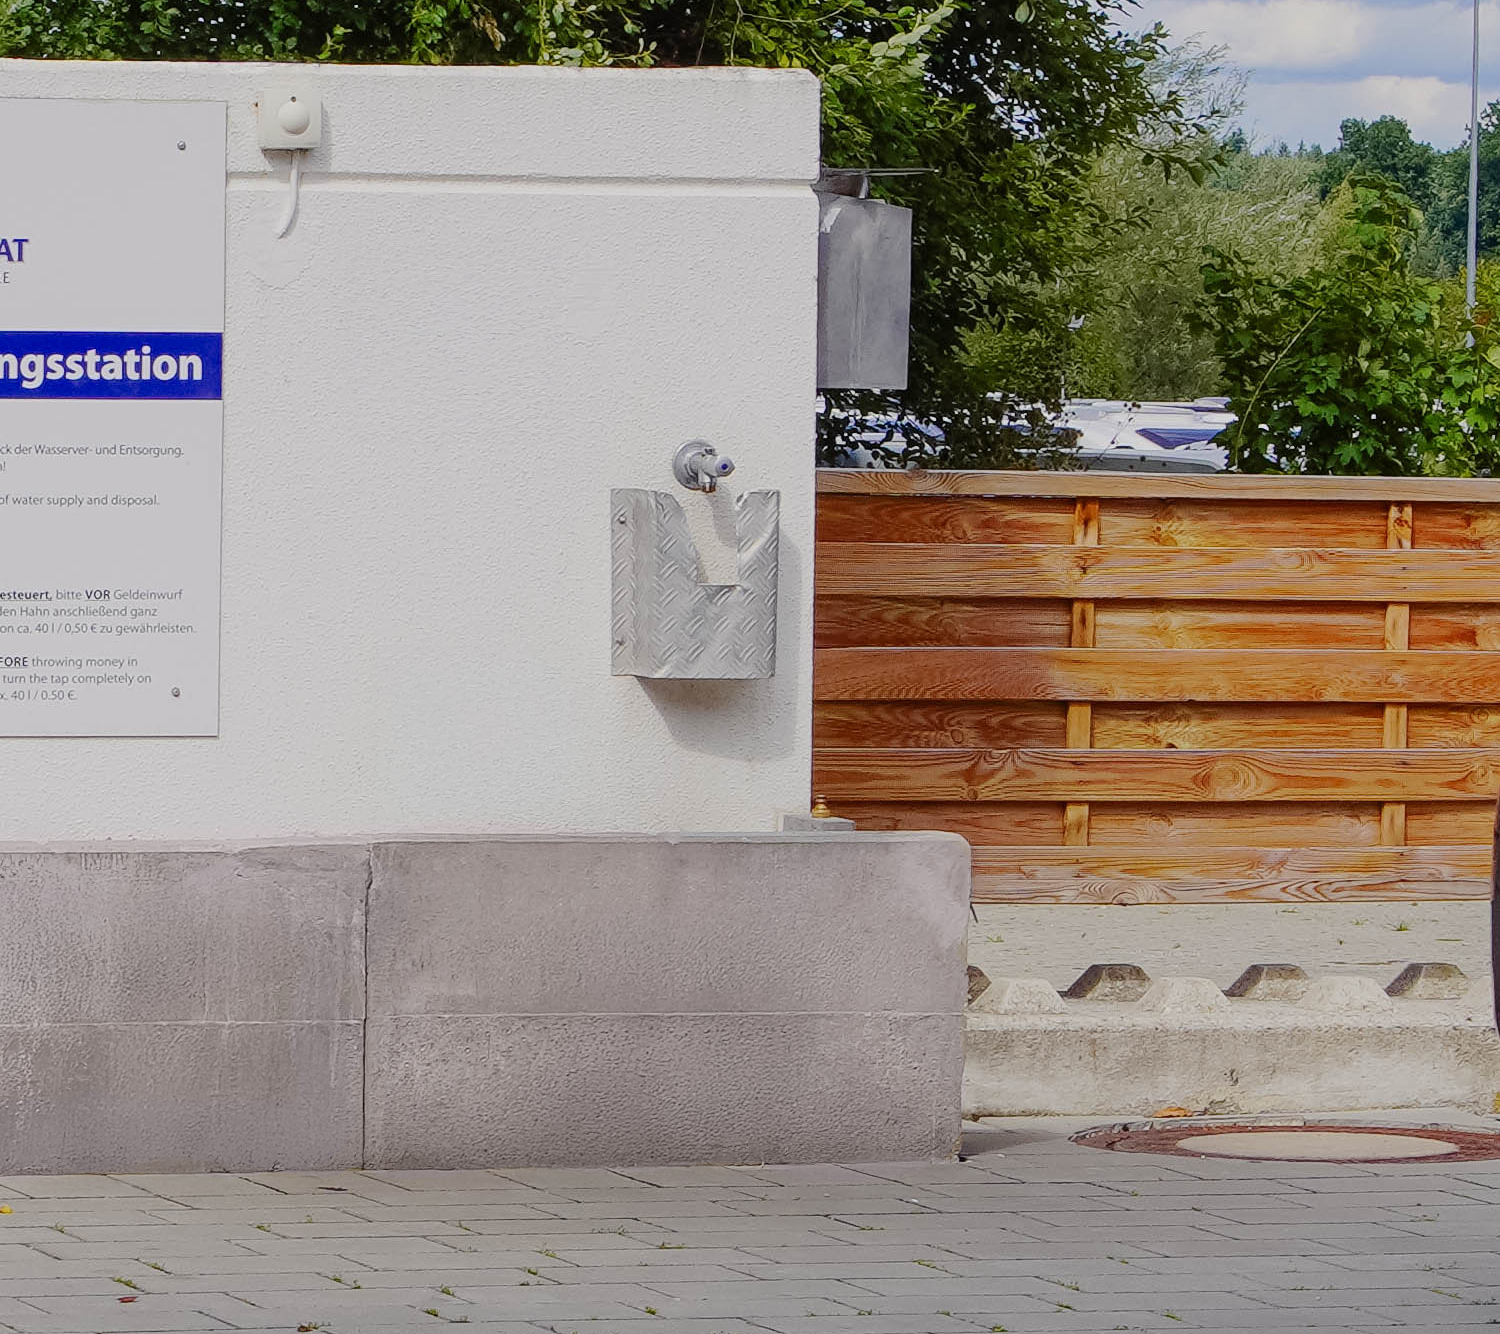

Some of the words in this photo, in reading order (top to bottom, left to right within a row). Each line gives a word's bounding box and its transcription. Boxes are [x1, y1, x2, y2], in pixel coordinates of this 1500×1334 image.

[14, 444, 32, 455] der
[35, 444, 93, 456] Wasserver-
[95, 444, 117, 456] und
[119, 444, 184, 458] Entsorgung.
[12, 495, 43, 506] water
[46, 494, 84, 508] supply
[86, 494, 108, 506] and
[111, 494, 160, 508] disposal.
[56, 588, 82, 600] bitte
[85, 588, 110, 600] VOR
[113, 588, 184, 600] Geldeinwurf
[20, 605, 50, 617] Hahn
[52, 605, 127, 617] anschließend
[130, 608, 158, 620] ganz
[35, 622, 48, 634] 40
[100, 625, 113, 634] zu
[115, 622, 197, 637] gewährleisten.
[32, 656, 83, 670] throwing
[85, 658, 125, 670] money
[127, 655, 138, 667] in
[2, 674, 26, 684] turn
[29, 672, 48, 684] the
[50, 673, 69, 687] tap
[72, 672, 134, 687] completely
[137, 675, 152, 684] on
[10, 689, 25, 701] 40
